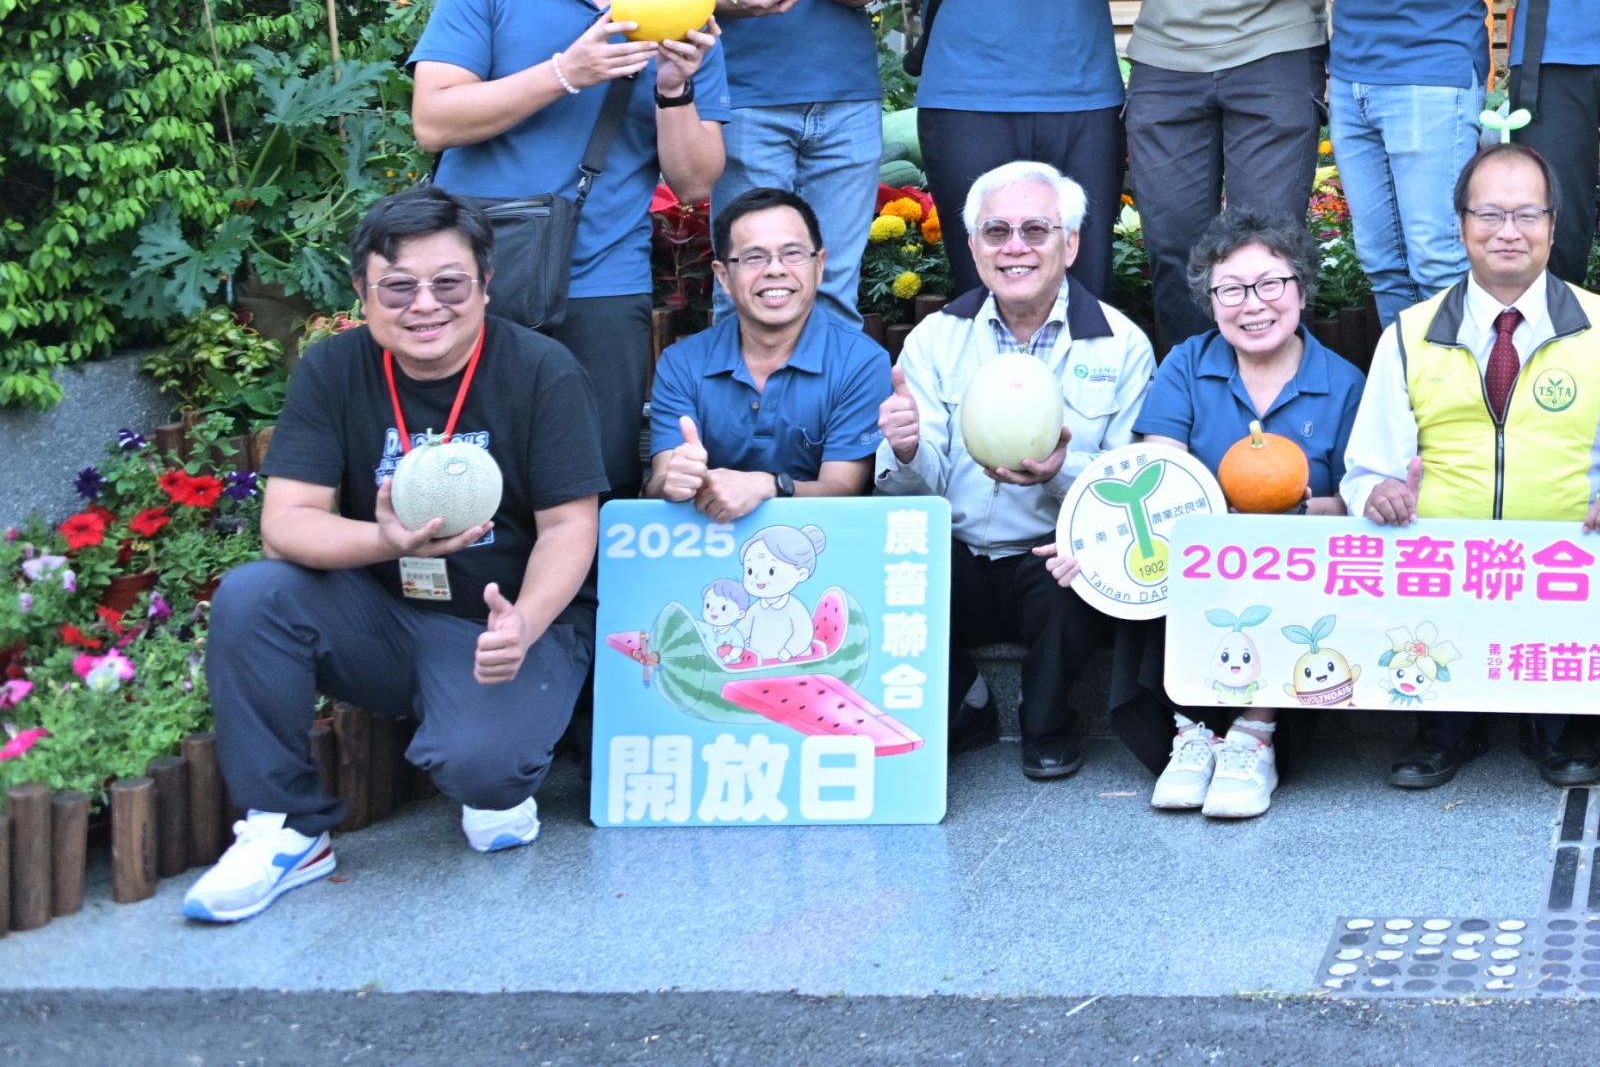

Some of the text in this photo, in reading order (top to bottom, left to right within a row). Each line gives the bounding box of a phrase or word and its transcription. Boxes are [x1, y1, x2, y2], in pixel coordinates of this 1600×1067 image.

[1538, 386, 1572, 399] TSTA
[1103, 454, 1148, 477] 農業部
[605, 523, 736, 558] 2025
[1073, 497, 1207, 551] 臺南區 農業改良場
[1138, 560, 1166, 577] 1902
[1088, 571, 1169, 602] Tainan DAR
[879, 509, 929, 709] 農畜聯合
[607, 733, 876, 824] 開放日
